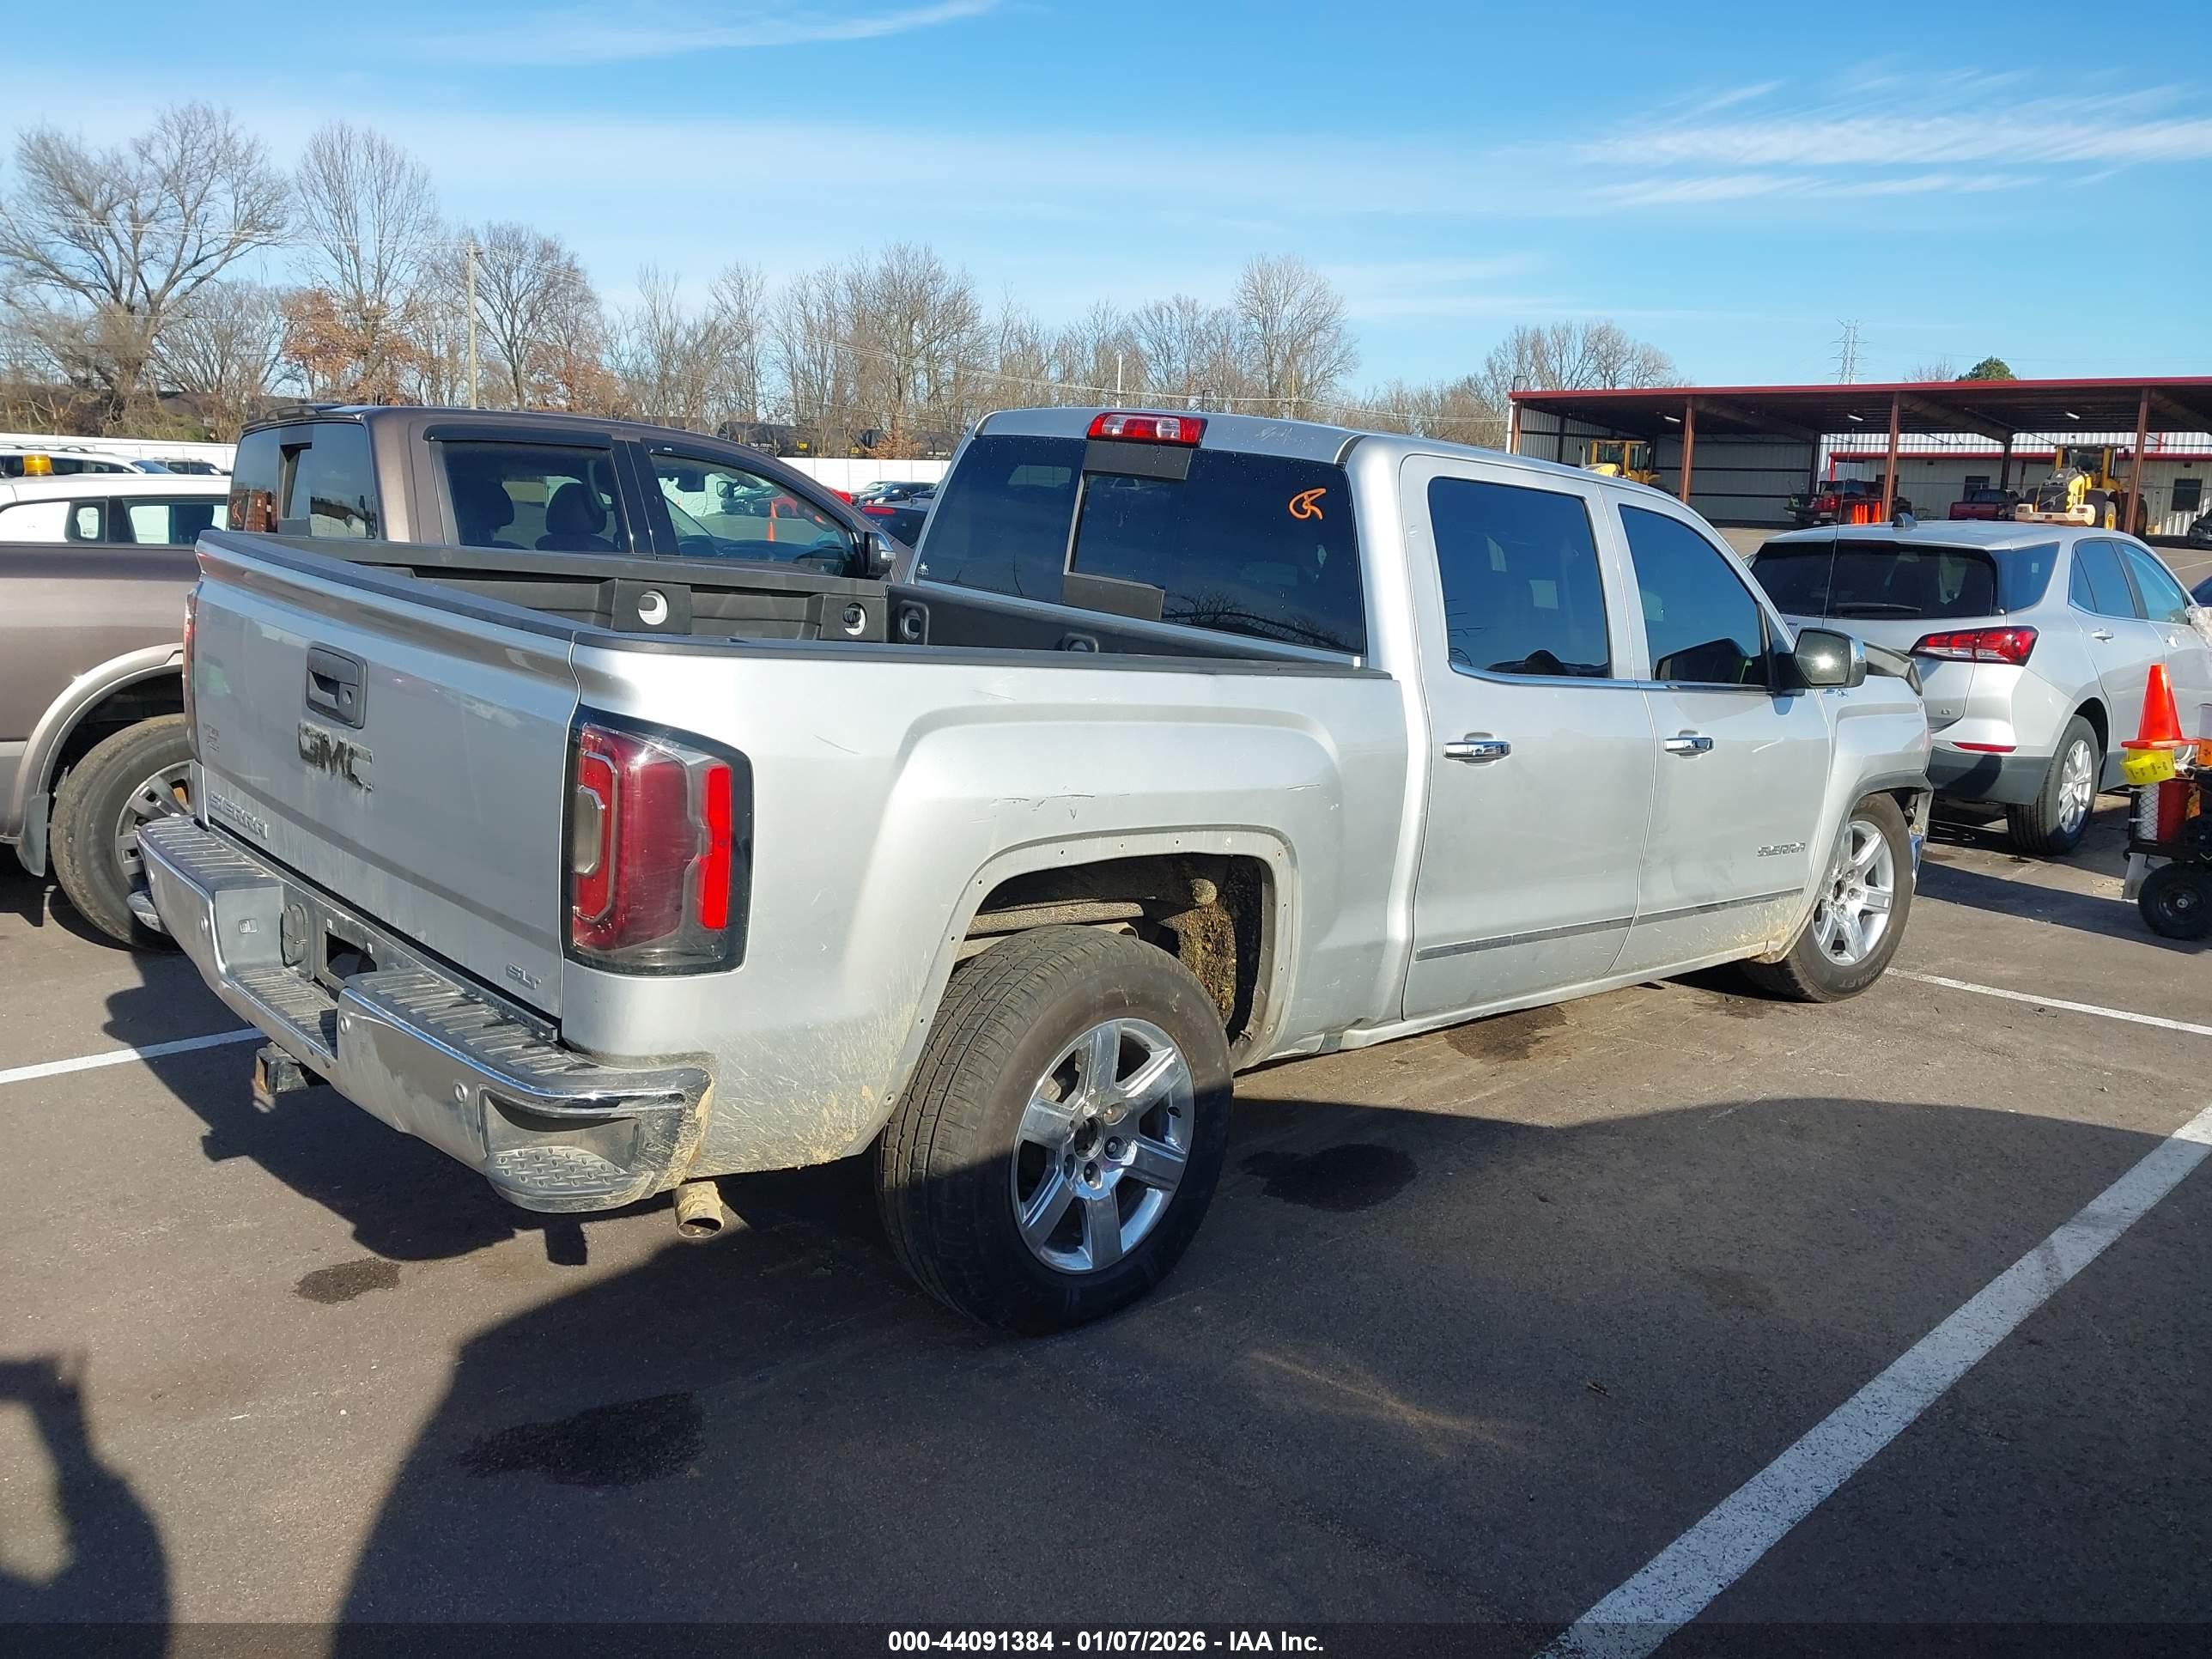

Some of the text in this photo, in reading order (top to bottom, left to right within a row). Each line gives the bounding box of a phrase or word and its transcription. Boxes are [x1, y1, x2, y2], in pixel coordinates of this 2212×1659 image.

[298, 721, 374, 791] GMC
[209, 790, 268, 839] SIERRA
[1757, 842, 1807, 858] SIERRA
[506, 962, 543, 990] SLT
